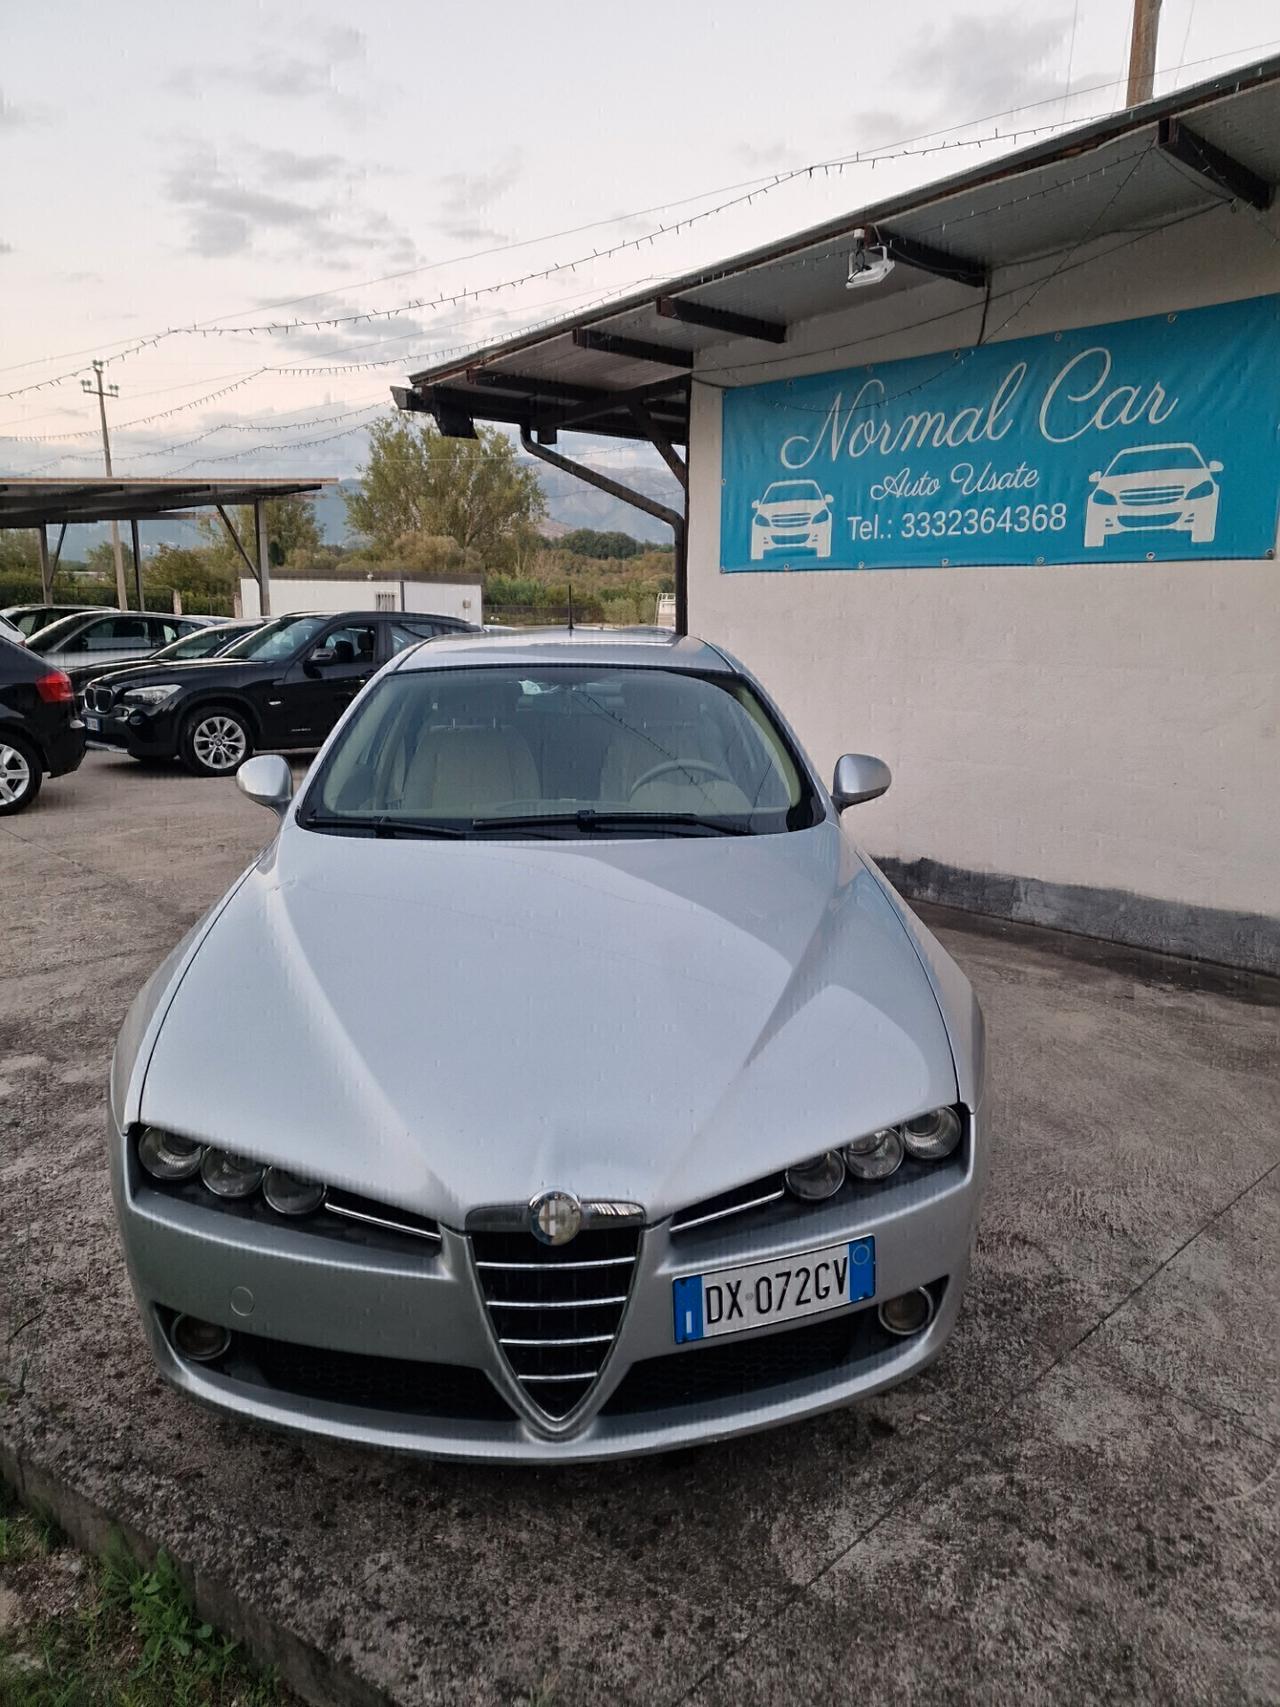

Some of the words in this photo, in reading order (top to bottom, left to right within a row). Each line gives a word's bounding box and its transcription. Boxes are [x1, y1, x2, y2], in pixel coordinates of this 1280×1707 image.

[780, 362, 1027, 469] Normal
[1038, 347, 1179, 443] Car
[870, 467, 940, 500] Auto
[950, 460, 1039, 492] Usate
[847, 516, 892, 541] Tel.:
[900, 503, 1067, 538] 3332364368
[705, 1280, 743, 1324] DX
